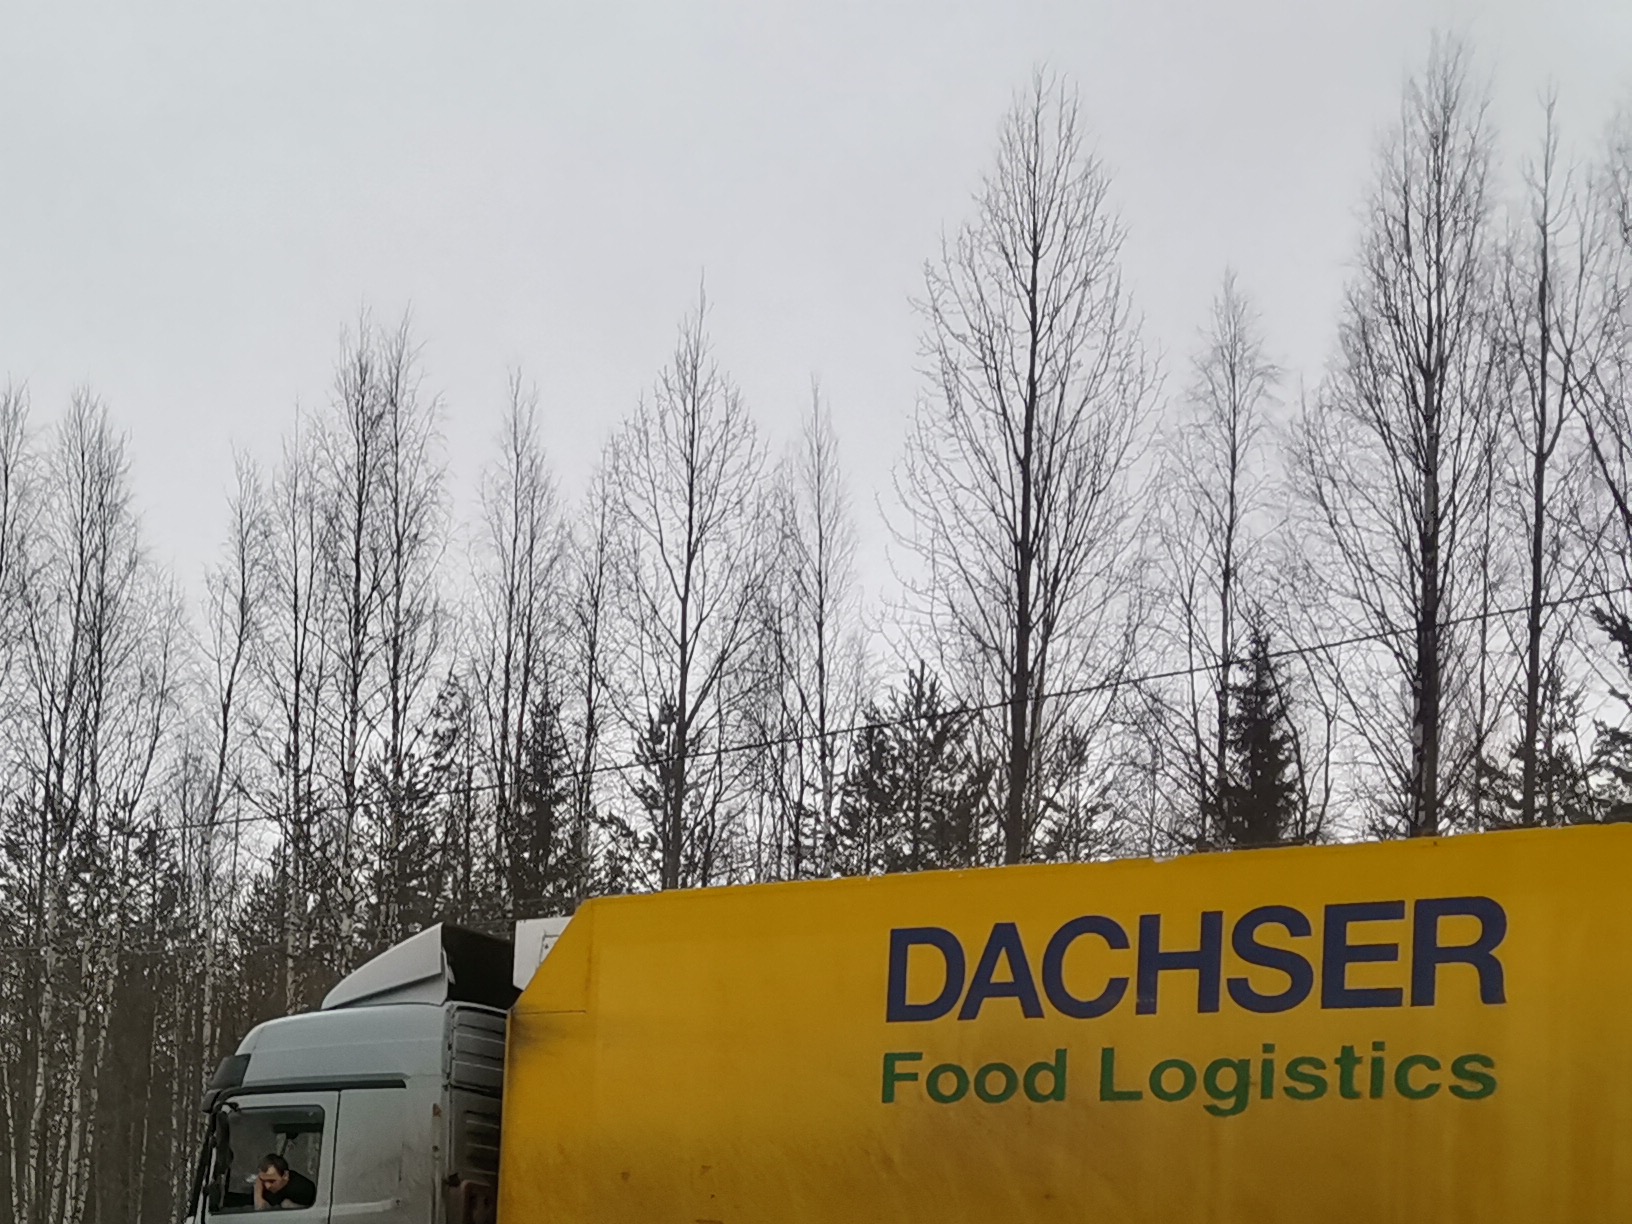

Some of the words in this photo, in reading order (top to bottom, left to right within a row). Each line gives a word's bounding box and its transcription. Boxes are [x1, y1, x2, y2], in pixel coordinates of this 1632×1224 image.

[885, 896, 1507, 1023] DACHSER
[881, 1047, 1068, 1104] Food
[1099, 1041, 1497, 1118] Logistics
